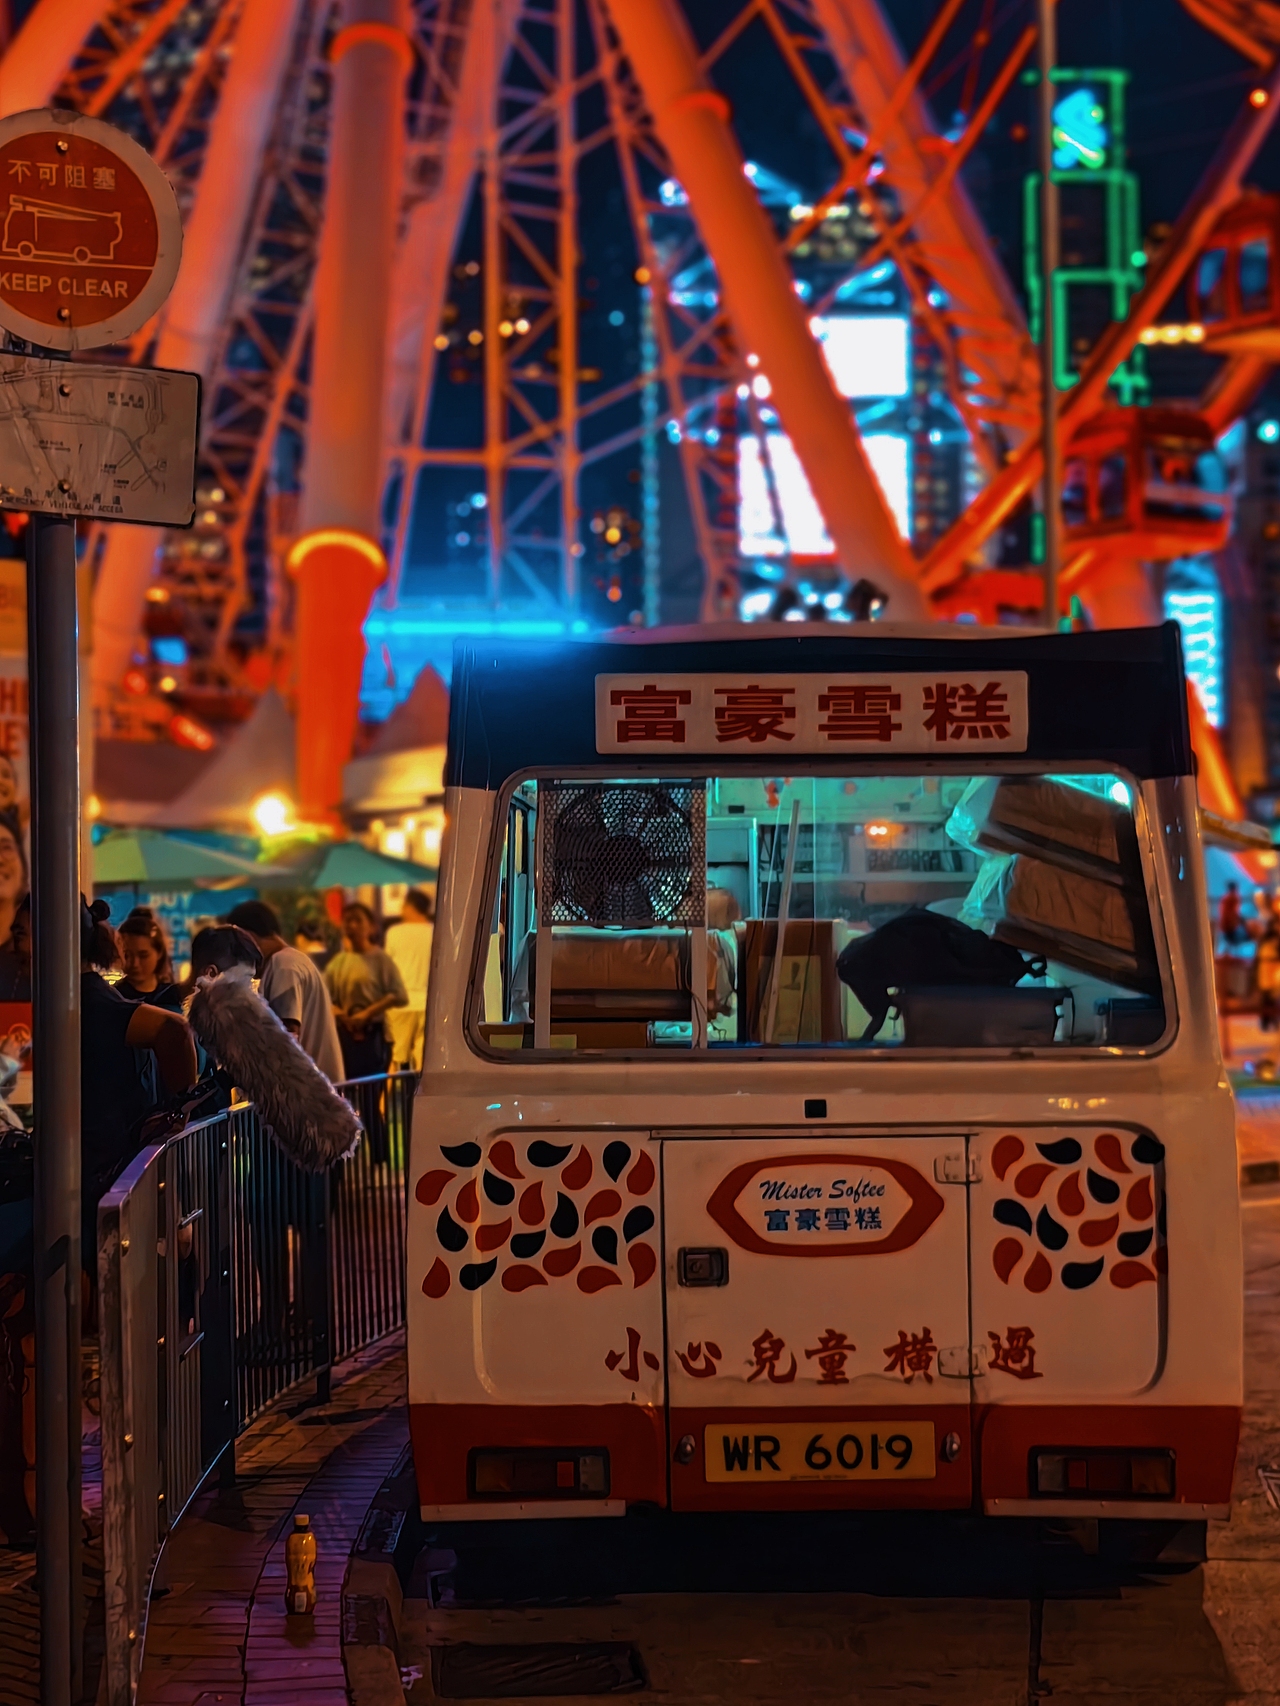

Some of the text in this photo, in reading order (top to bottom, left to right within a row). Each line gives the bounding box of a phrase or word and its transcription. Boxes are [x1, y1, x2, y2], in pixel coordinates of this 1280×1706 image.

[8, 159, 116, 190] 不可阻塞
[0, 271, 128, 298] KEEP CLEAR
[610, 681, 1011, 743] 富豪雪糕
[759, 1171, 886, 1204] Mister Softee
[763, 1206, 883, 1232] 富豪雪糕
[722, 1433, 914, 1472] WR 6019
